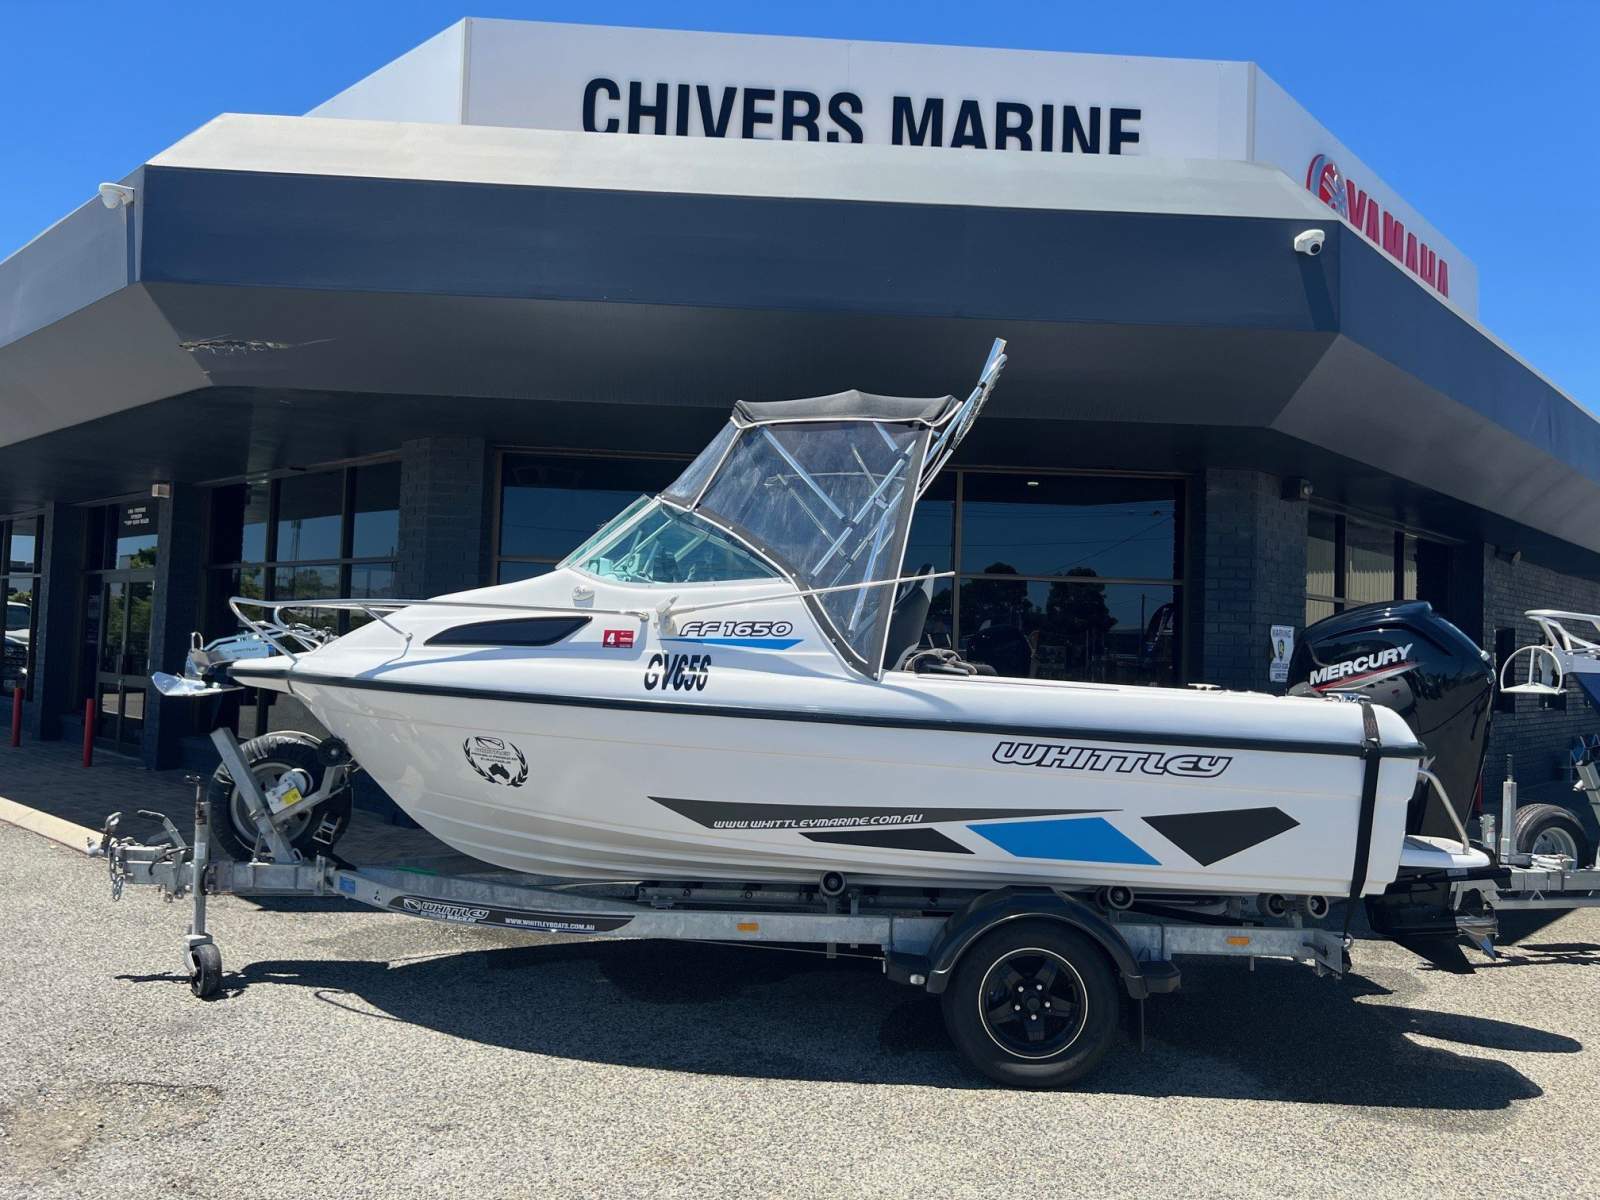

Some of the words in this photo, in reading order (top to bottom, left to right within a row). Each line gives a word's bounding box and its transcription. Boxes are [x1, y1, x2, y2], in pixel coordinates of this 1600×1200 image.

[582, 77, 864, 144] CHIVERS
[891, 95, 1142, 155] MARINE
[607, 632, 616, 645] 4
[1309, 643, 1414, 686] MERCURY
[992, 741, 1233, 778] WHITTLEY
[713, 814, 923, 829] WWW.WHITTLEYMARINE.COM.AU
[421, 901, 490, 920] WHITTLEY
